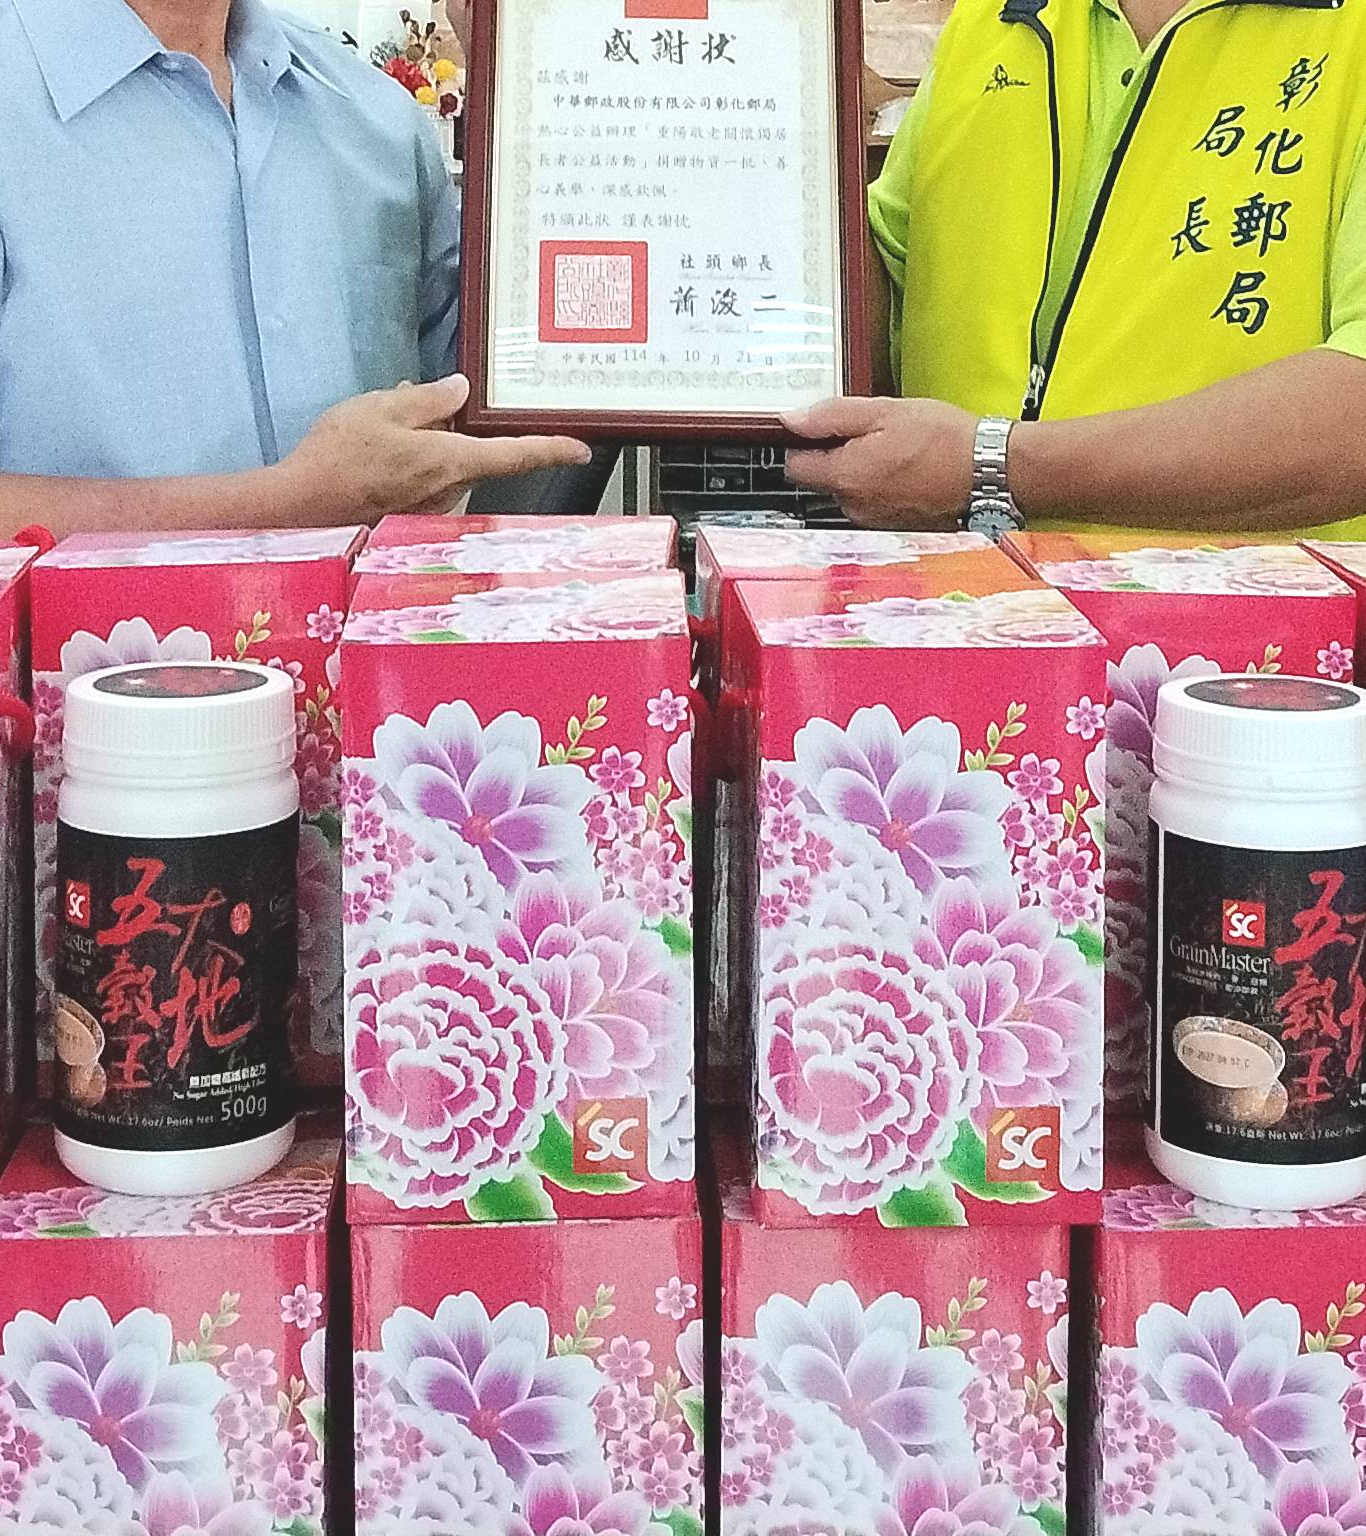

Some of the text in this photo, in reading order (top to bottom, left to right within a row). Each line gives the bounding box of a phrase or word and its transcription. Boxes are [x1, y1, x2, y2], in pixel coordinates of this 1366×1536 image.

[603, 27, 737, 65] 感謝狀
[552, 94, 777, 113] 中華郵政股份有限公司彰化郵局
[1171, 104, 1247, 261] 局長
[1209, 52, 1331, 335] 彰化郵局
[679, 253, 774, 272] 社頭鄉長
[1169, 934, 1271, 974] GrainMaster
[220, 1094, 267, 1122] 500g
